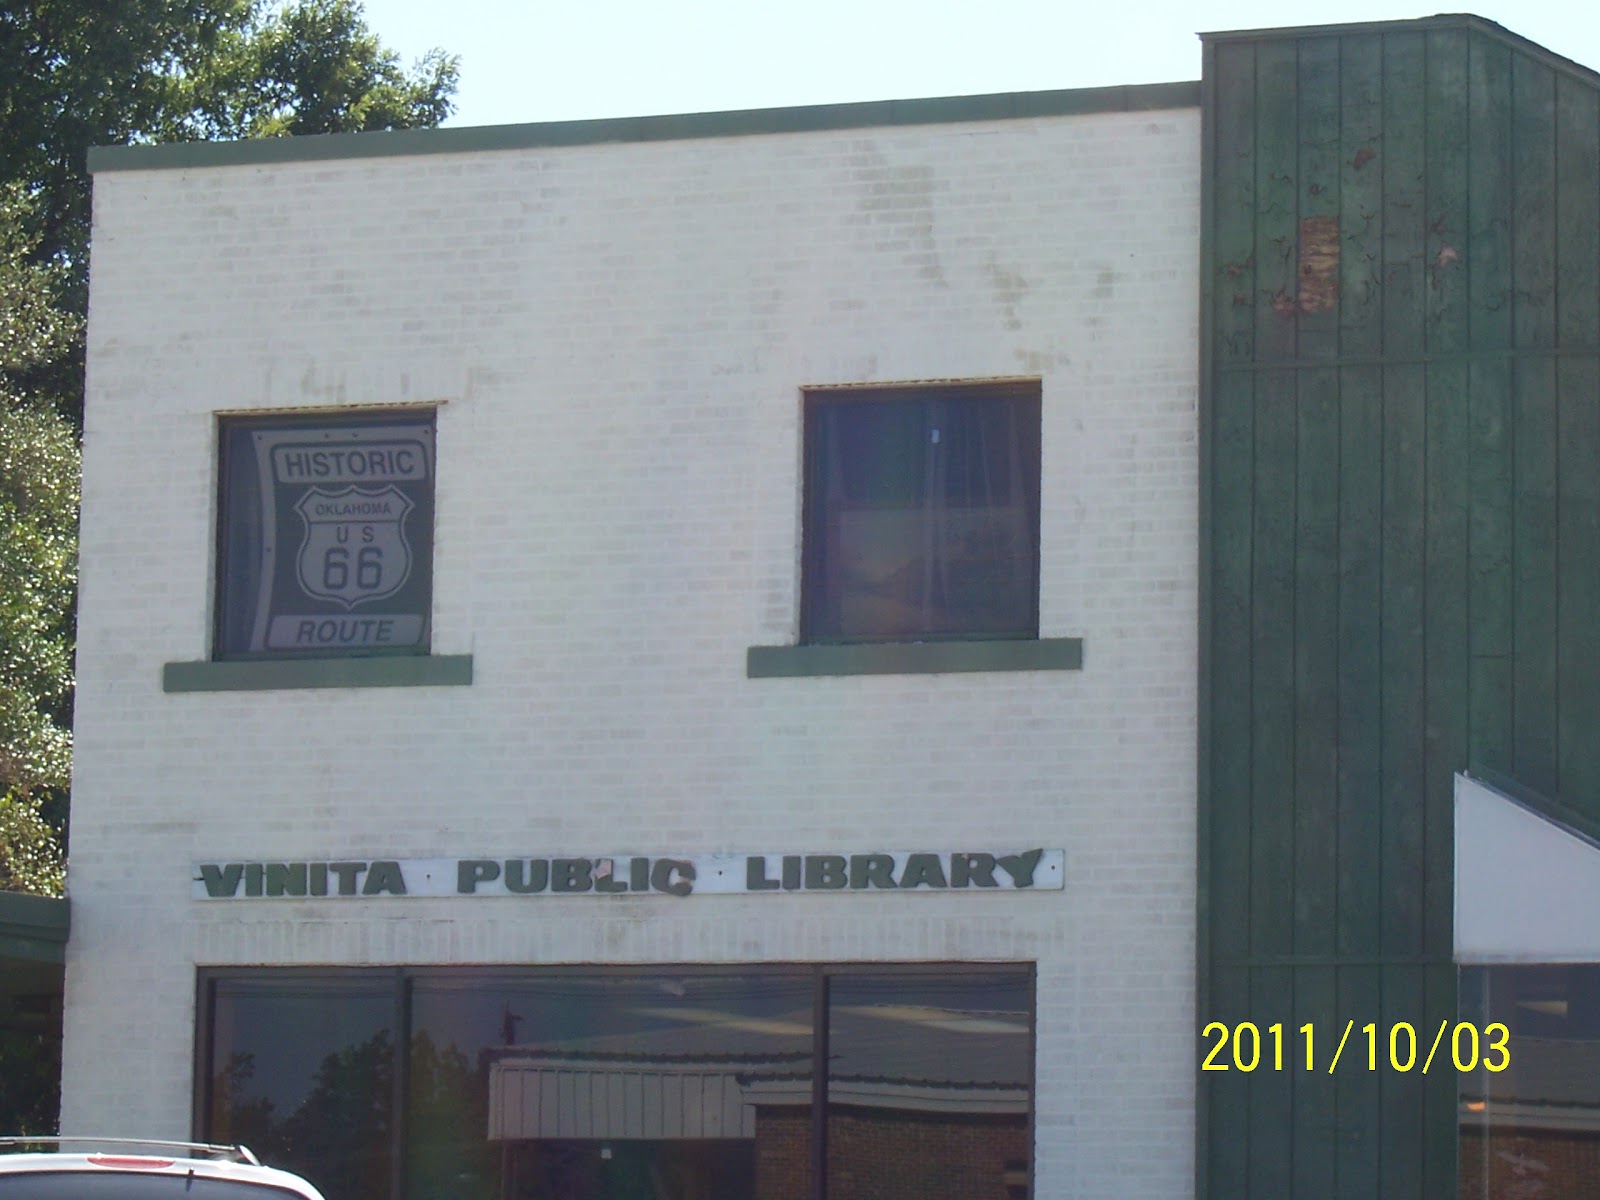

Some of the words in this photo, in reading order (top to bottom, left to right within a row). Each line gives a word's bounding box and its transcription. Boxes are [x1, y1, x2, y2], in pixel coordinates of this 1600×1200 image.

[285, 450, 415, 478] HISTORIC
[315, 502, 392, 516] OKLAHOMA
[323, 547, 383, 590] 66
[296, 619, 394, 642] ROUTE
[200, 860, 407, 898] VINITA
[456, 857, 696, 897] PUBLIC
[746, 848, 1043, 890] LIBRARY
